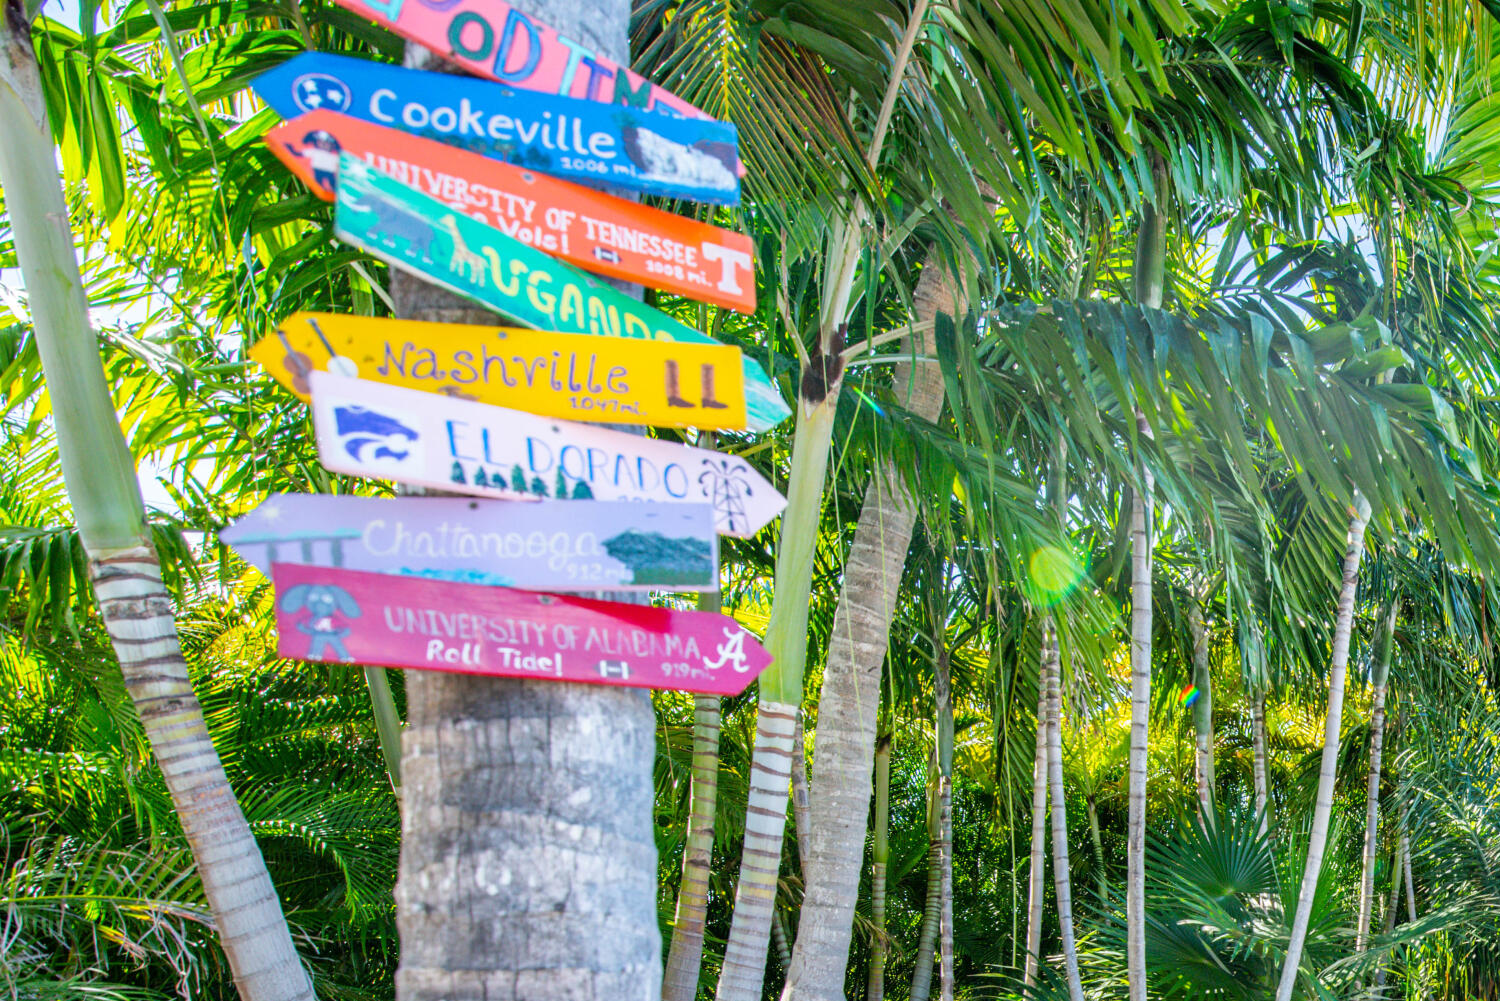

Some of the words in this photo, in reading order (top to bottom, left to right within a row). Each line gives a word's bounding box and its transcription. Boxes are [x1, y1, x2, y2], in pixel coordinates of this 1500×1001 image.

[364, 0, 542, 83] OD
[557, 35, 684, 118] TIM
[369, 88, 617, 159] Cookeville
[497, 214, 570, 254] Vols!
[545, 207, 576, 232] OF
[581, 216, 697, 267] TENNESSEE
[482, 246, 675, 342] UGAND
[701, 241, 751, 296] T
[377, 341, 629, 394] Nashville
[446, 420, 509, 468] EL
[526, 437, 689, 499] DORADO
[362, 519, 602, 572] Chattanooga
[384, 605, 547, 647] UNIVERSITY
[552, 623, 581, 650] OF
[585, 627, 700, 659] ALABAMA
[426, 639, 481, 665] Roll
[497, 647, 563, 677] Tide!
[703, 626, 749, 673] A
